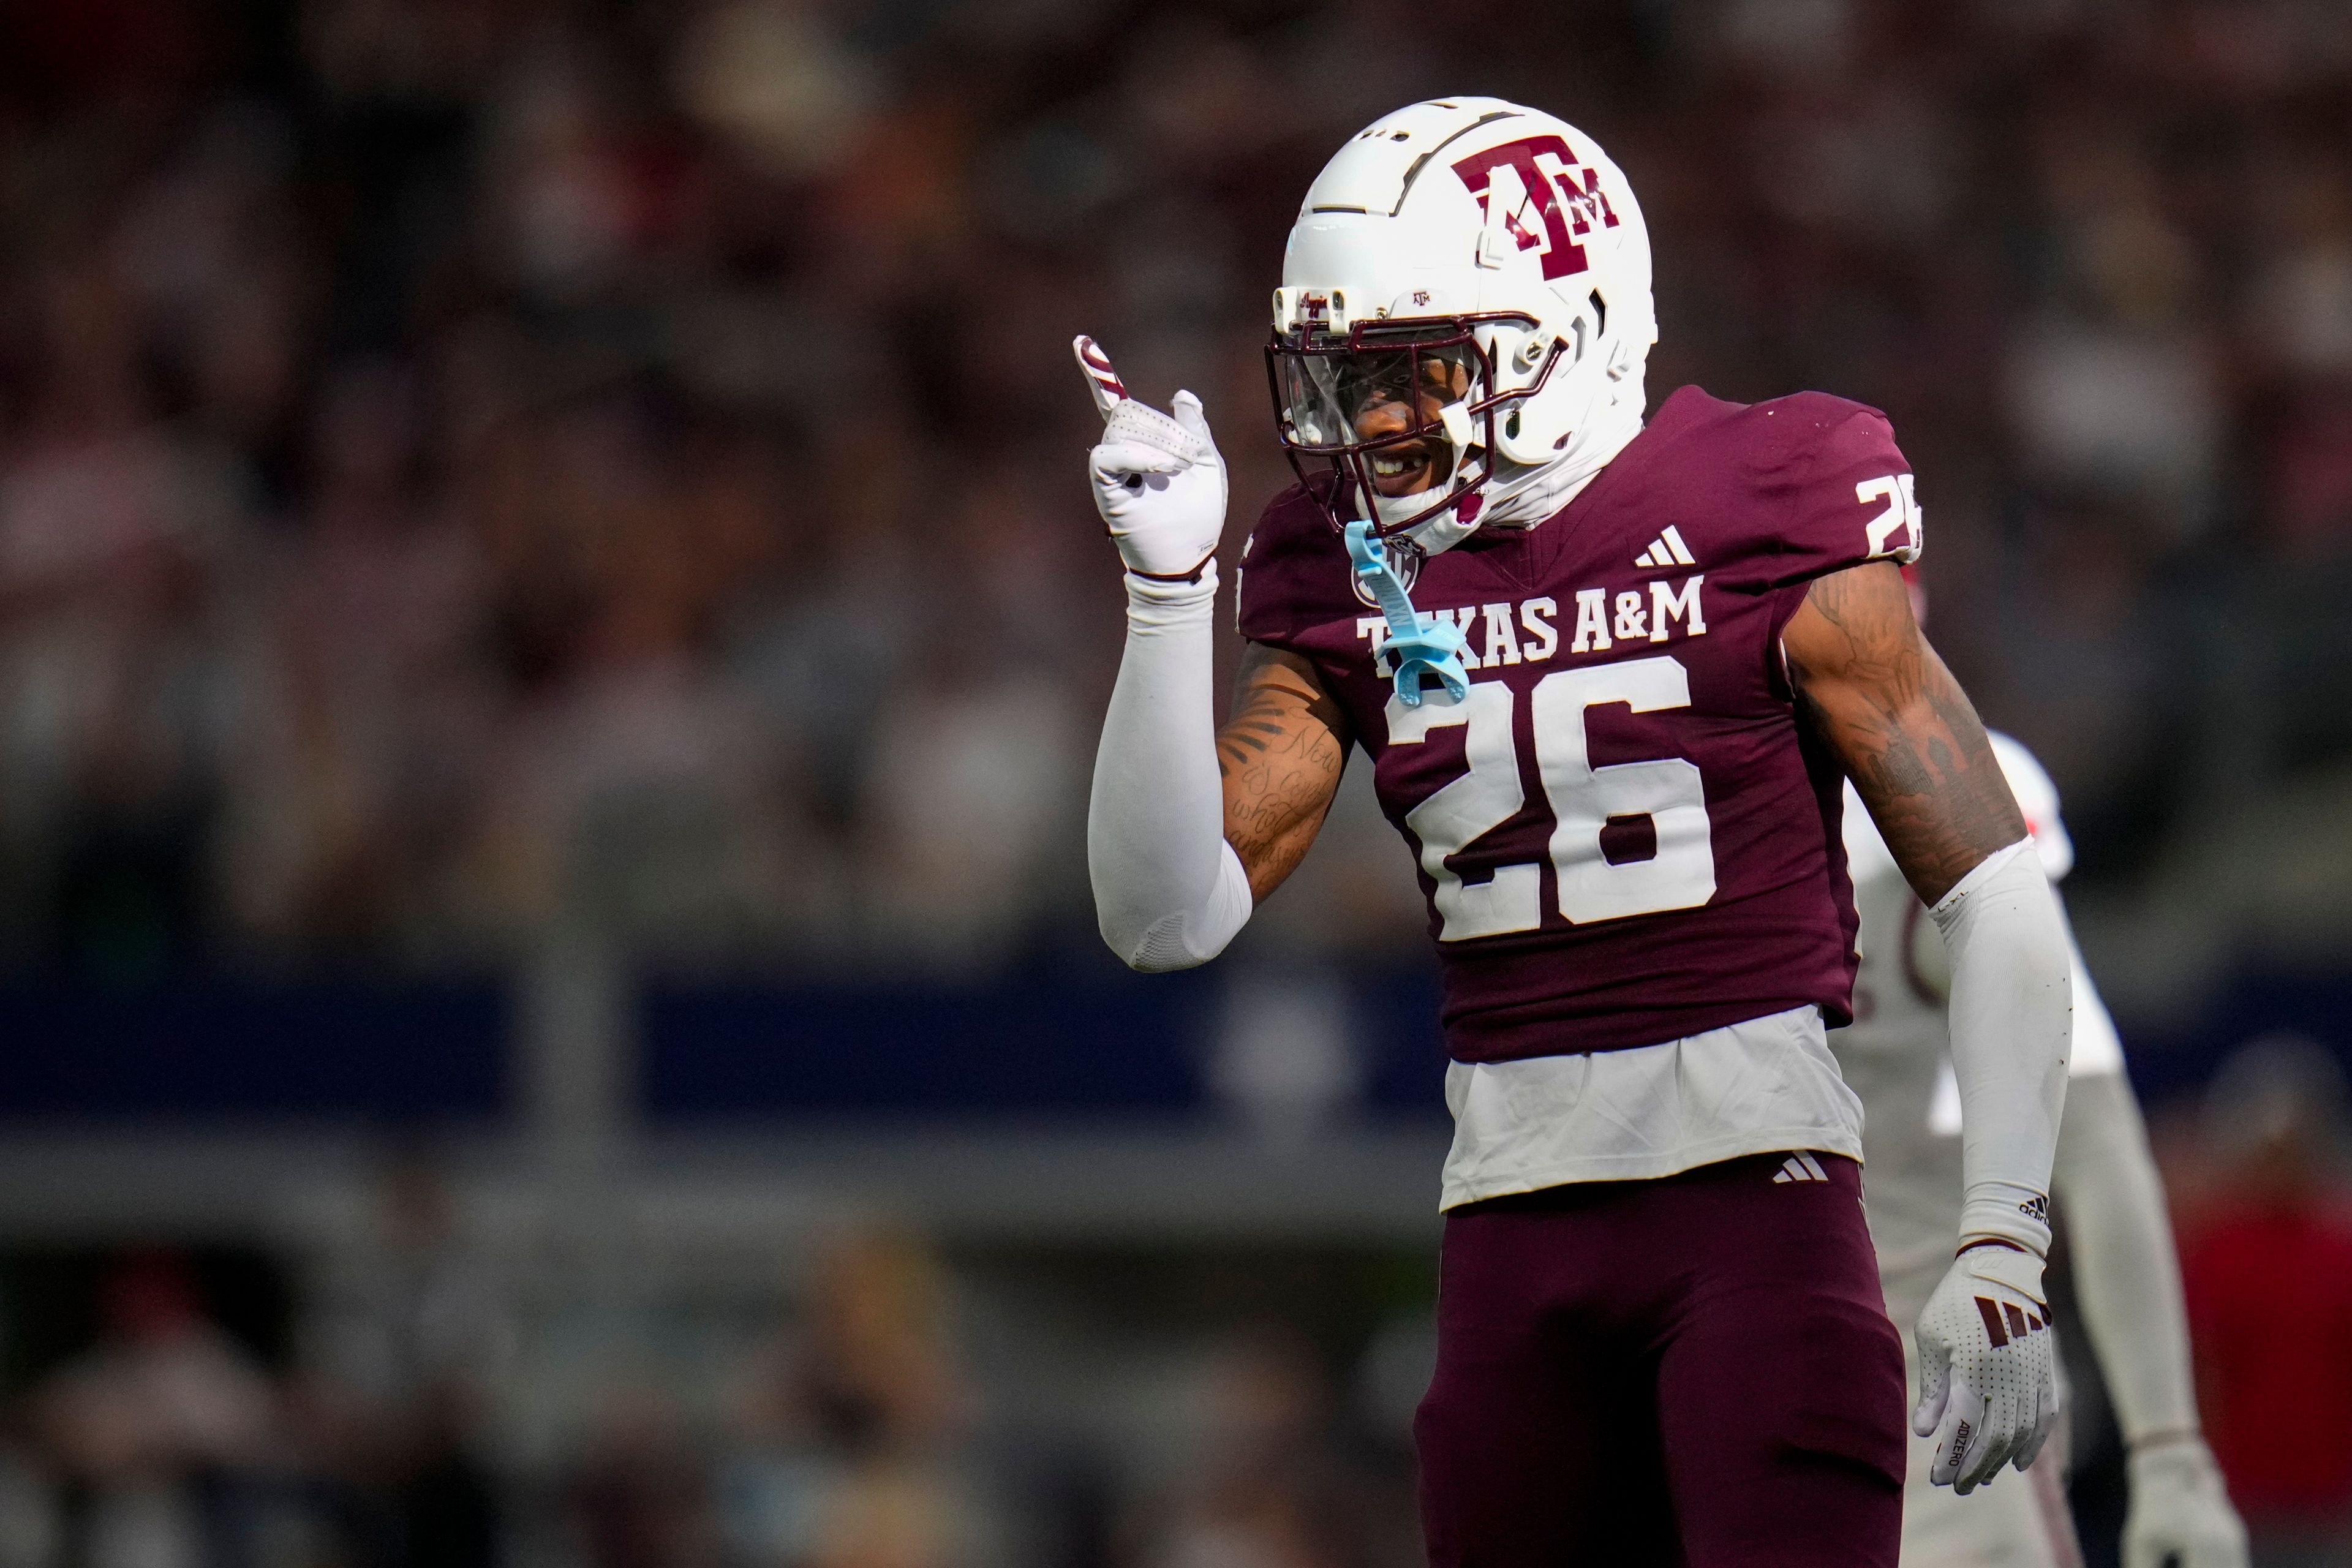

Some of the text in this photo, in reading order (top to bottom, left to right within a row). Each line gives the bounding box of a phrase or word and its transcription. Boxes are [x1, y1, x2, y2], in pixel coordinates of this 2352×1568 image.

[1357, 575, 1706, 678] TXAS A&M
[1384, 655, 1717, 941] 26
[1948, 1419, 1970, 1466] ADIZERO
